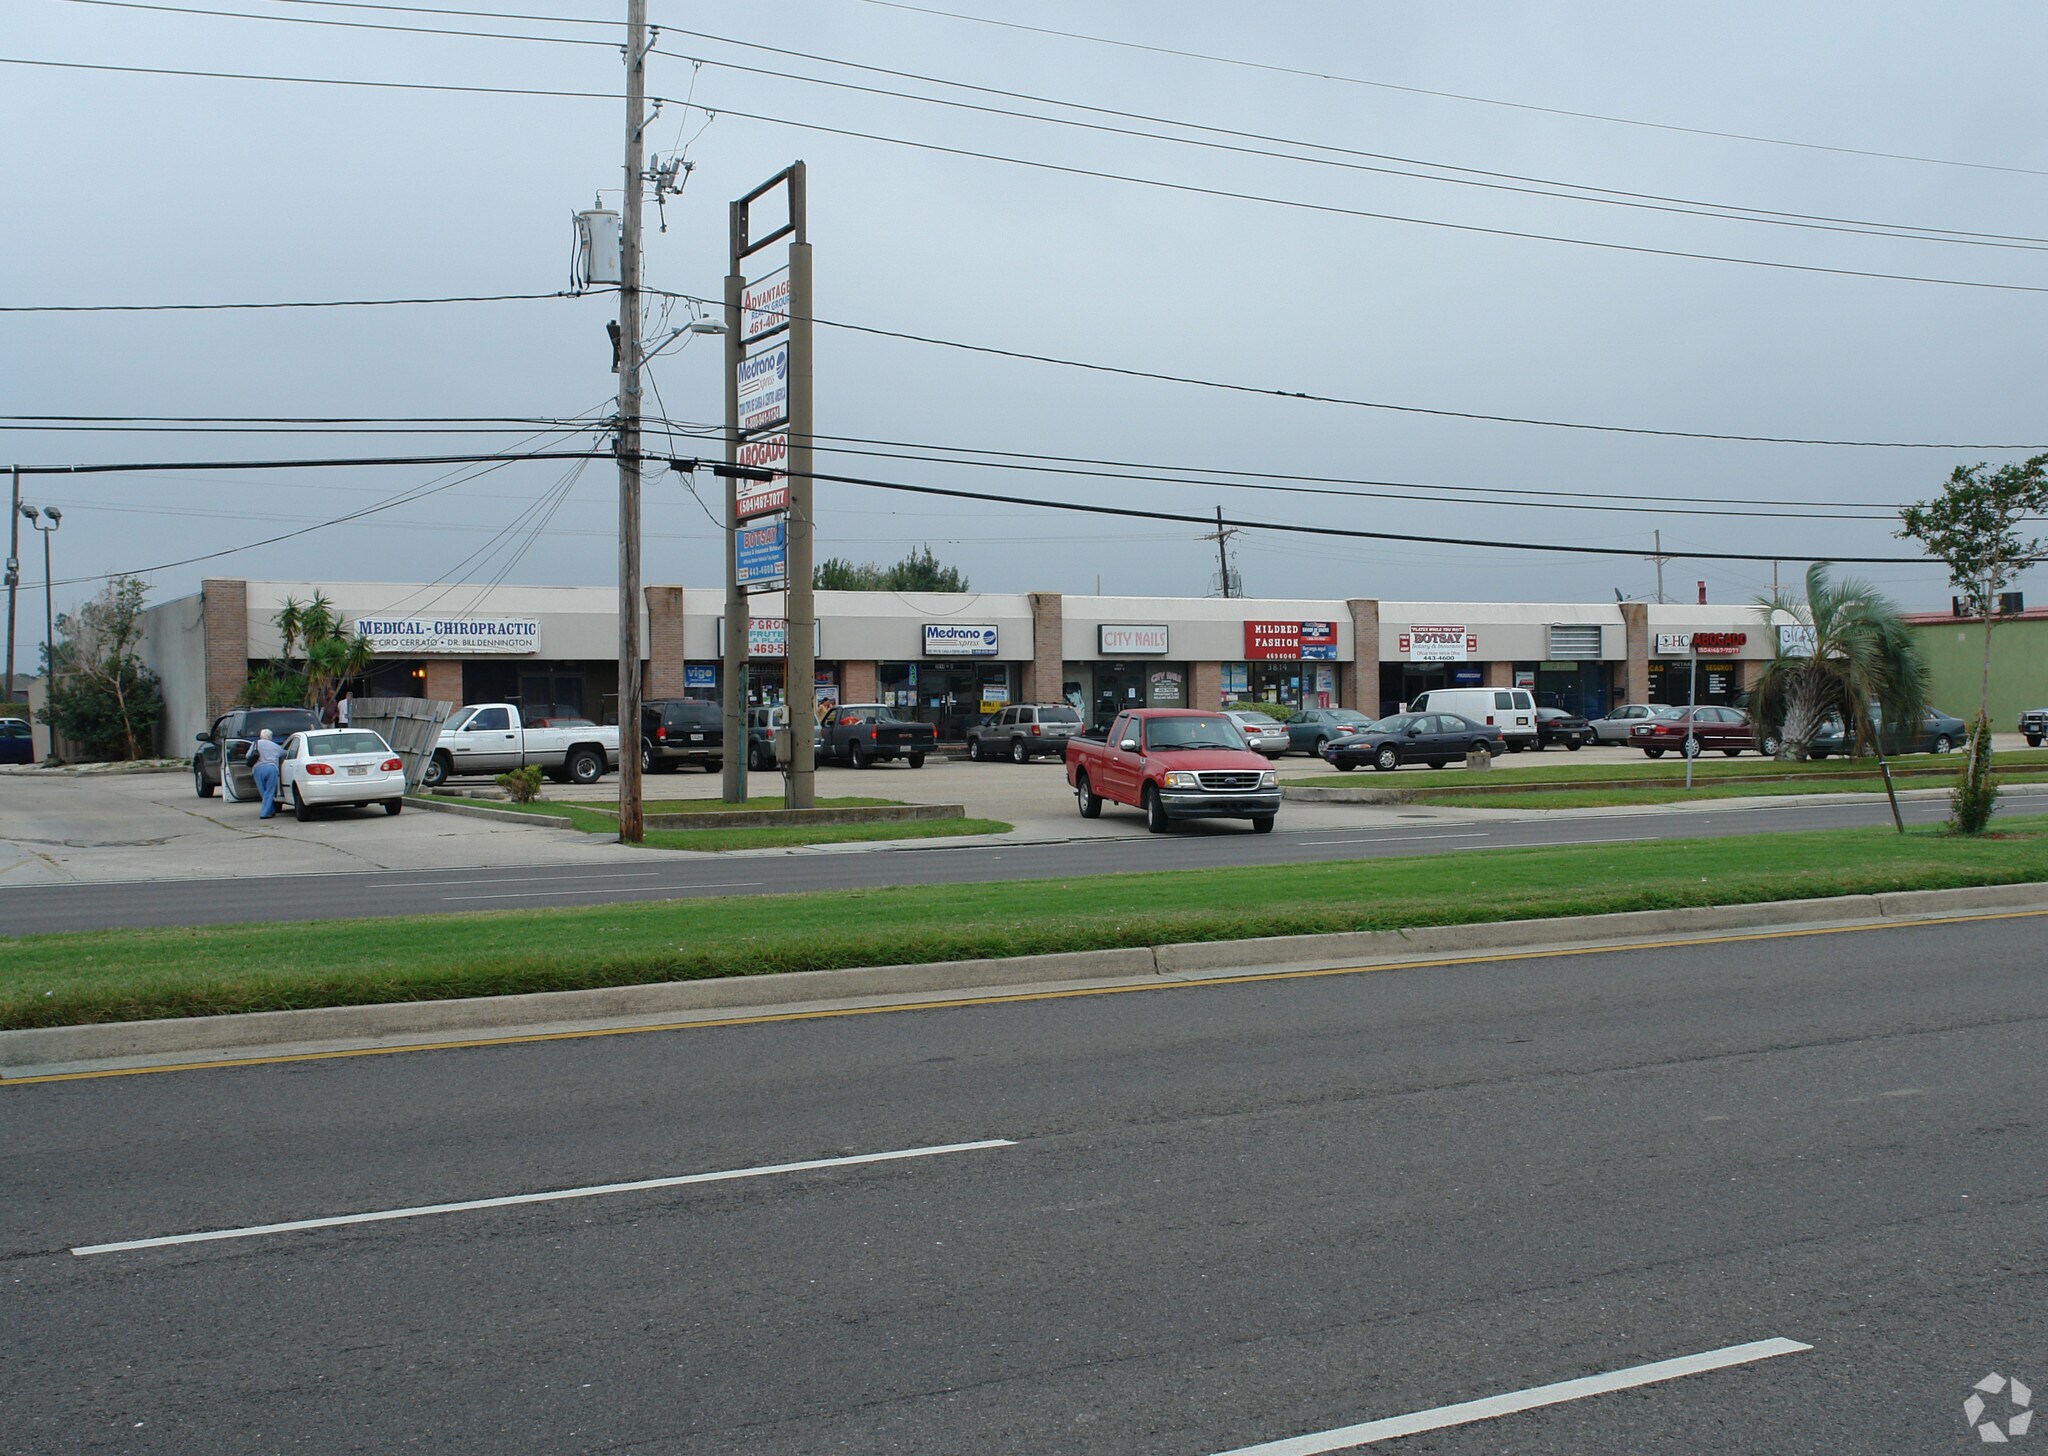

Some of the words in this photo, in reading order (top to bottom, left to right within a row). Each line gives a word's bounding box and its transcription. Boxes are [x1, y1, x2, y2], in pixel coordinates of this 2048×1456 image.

[744, 280, 791, 314] ADVANTAGE
[749, 309, 785, 335] 461-4011
[738, 354, 775, 383] Medrano
[739, 435, 786, 466] ABOGADO
[739, 490, 785, 515] (504)467-7077
[743, 527, 777, 548] BOTSAY
[358, 620, 424, 635] MEDICAL
[434, 621, 537, 635] CHIROPRACTIC
[927, 626, 980, 639] Medrano
[1255, 625, 1299, 634] MILDRED
[379, 639, 398, 647] CIRO
[400, 639, 438, 647] CERRATO
[447, 639, 461, 647] DR.
[462, 639, 476, 647] BILL
[477, 639, 533, 647] DENNINGTON
[1104, 632, 1132, 646] CITY
[1135, 632, 1165, 646] NAILS
[1255, 638, 1299, 647] FASHION
[1414, 633, 1462, 644] BOTSAY
[1672, 635, 1689, 647] HC
[1693, 632, 1747, 646] ABOGADO
[687, 667, 713, 679] vigo
